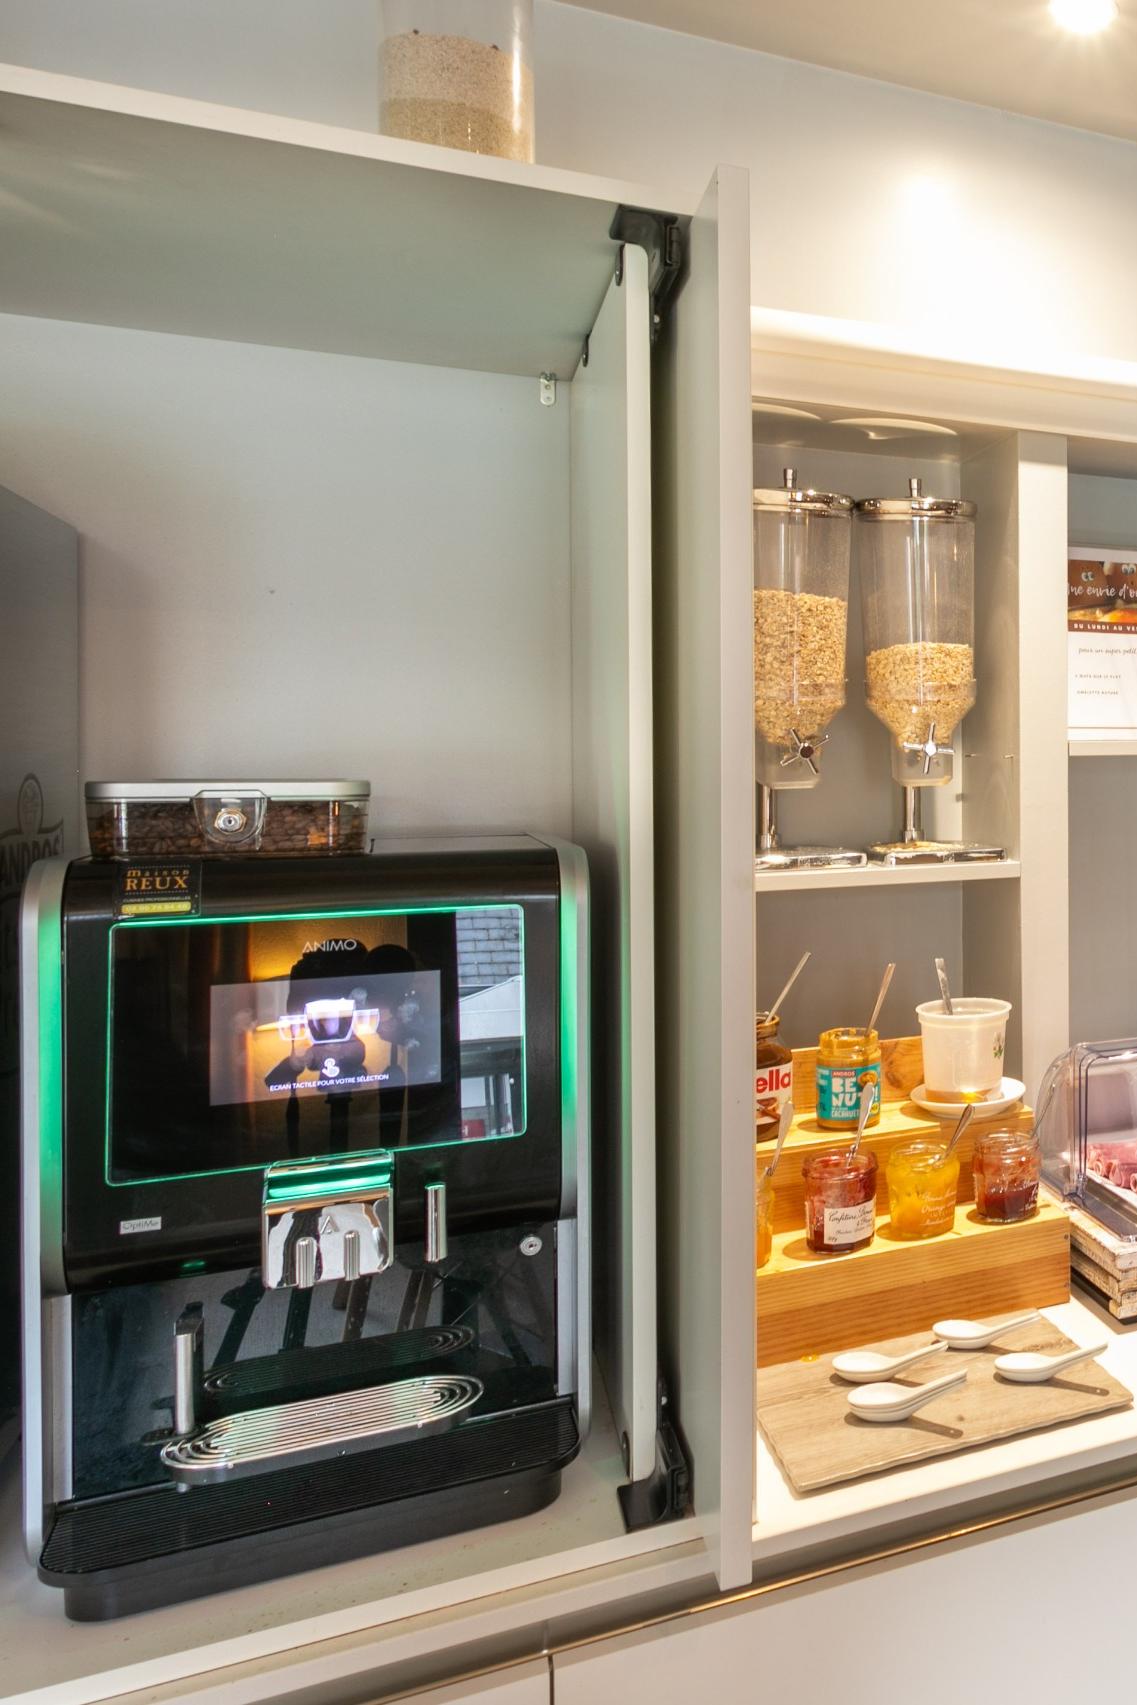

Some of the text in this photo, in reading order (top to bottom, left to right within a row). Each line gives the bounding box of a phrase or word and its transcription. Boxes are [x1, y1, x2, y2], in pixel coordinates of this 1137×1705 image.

[1087, 587, 1117, 598] envie
[125, 875, 189, 891] REUX
[302, 939, 357, 953] ANIMO
[269, 1073, 389, 1092] ECRAN TACTILE POUR VOTRE SÉLECTION
[831, 1077, 857, 1093] BE
